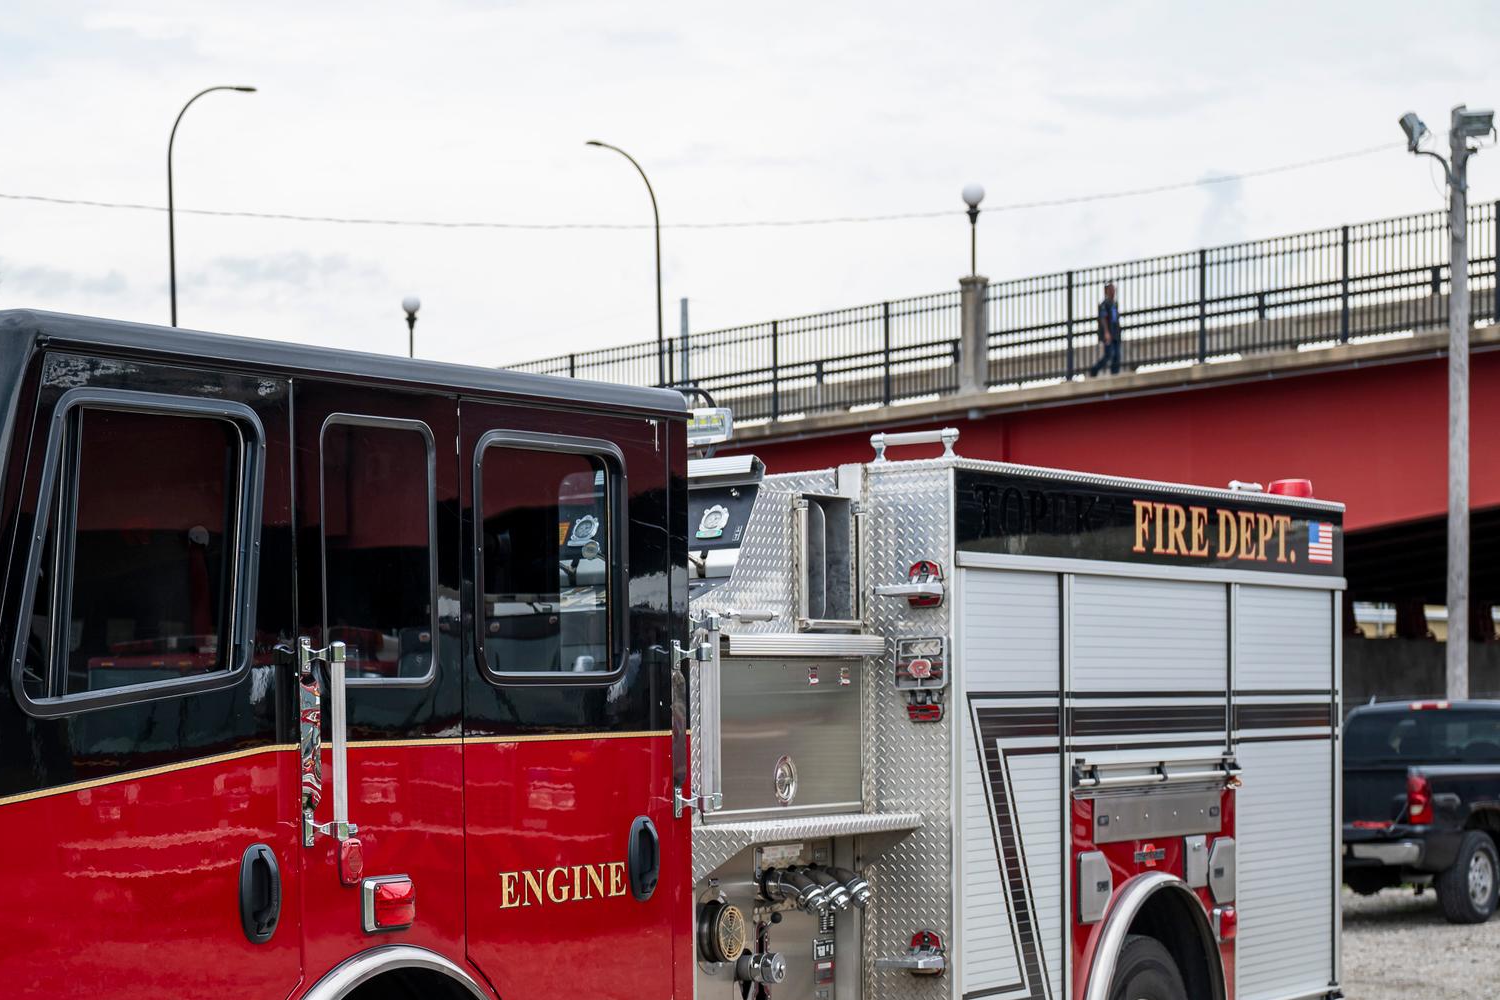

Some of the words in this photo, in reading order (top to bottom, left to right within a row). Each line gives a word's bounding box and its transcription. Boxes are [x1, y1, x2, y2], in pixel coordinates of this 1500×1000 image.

[1132, 499, 1211, 558] FIRE
[1216, 508, 1297, 564] DEPT.
[499, 861, 627, 909] ENGINE
